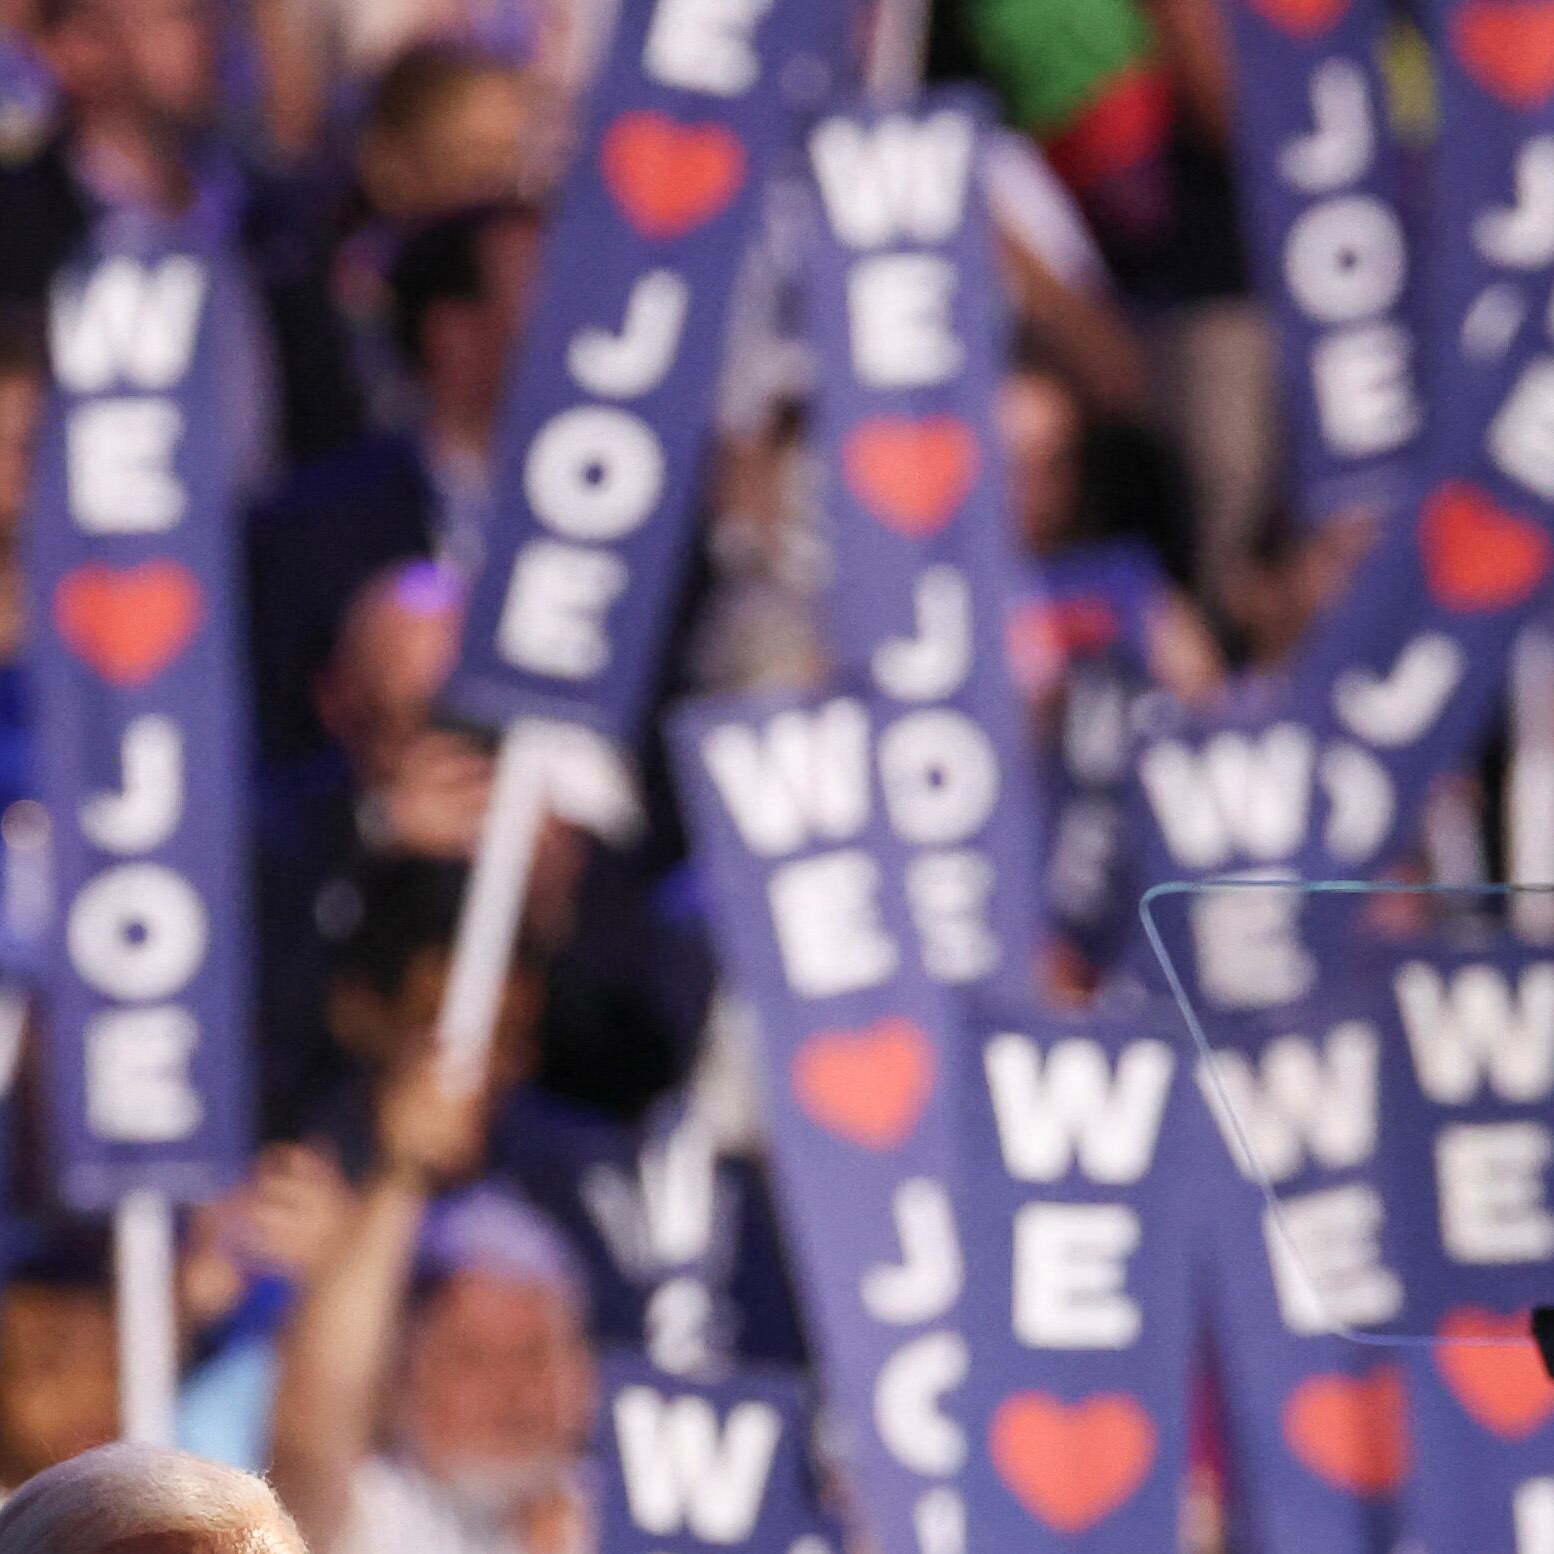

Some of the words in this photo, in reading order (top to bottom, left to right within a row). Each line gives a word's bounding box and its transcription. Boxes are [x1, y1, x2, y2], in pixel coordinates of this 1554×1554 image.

[46, 252, 205, 534] WE
[807, 108, 975, 391] WE
[1277, 55, 1423, 458] JOE
[494, 269, 692, 682] JOE
[65, 712, 210, 1143] JOE
[699, 697, 900, 1000] WE
[870, 562, 1003, 986] JOE
[1137, 720, 1317, 1012] WE
[983, 1031, 1177, 1351] WE
[1192, 1017, 1407, 1338] WE
